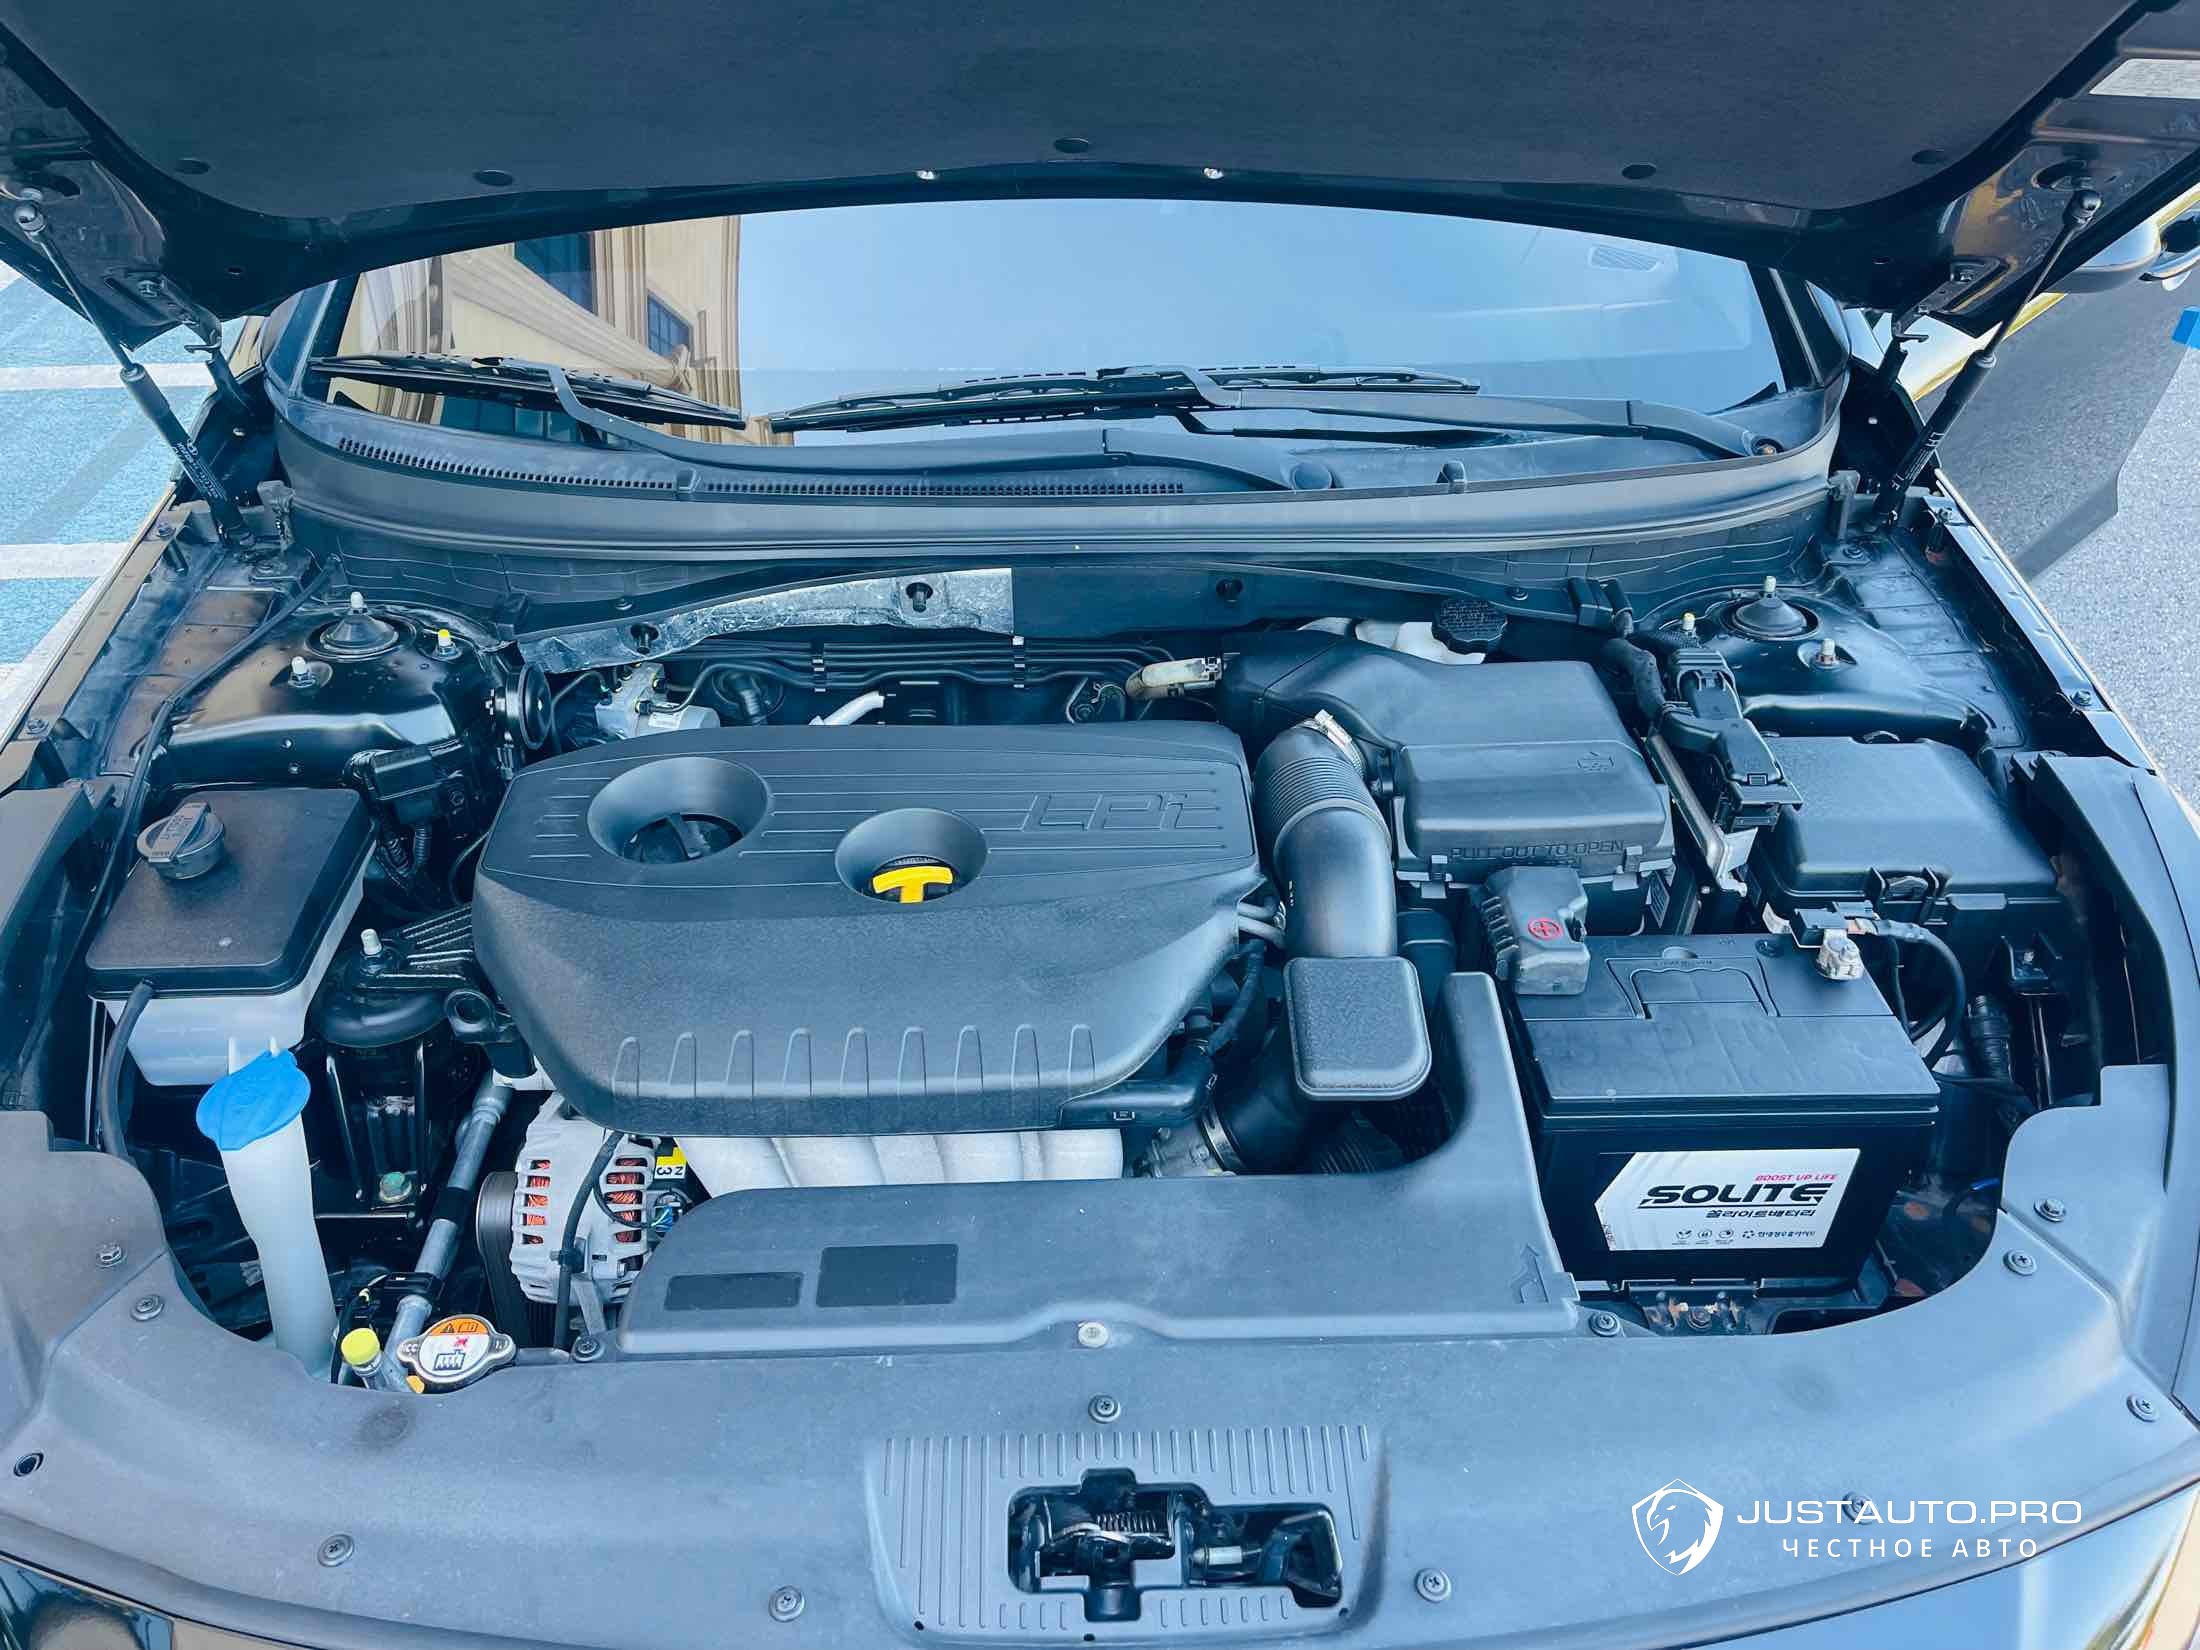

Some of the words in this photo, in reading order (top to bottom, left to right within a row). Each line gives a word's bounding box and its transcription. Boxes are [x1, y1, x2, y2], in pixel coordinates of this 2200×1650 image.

[1502, 845, 1538, 859] OUT
[1544, 843, 1568, 857] TO
[1575, 839, 1624, 856] OPEN
[1755, 1174, 1792, 1182] BOOST
[1814, 1173, 1837, 1181] LIFE
[1640, 1182, 1833, 1205] SOLITE
[1706, 1208, 1816, 1219] 쏠라이트배터리
